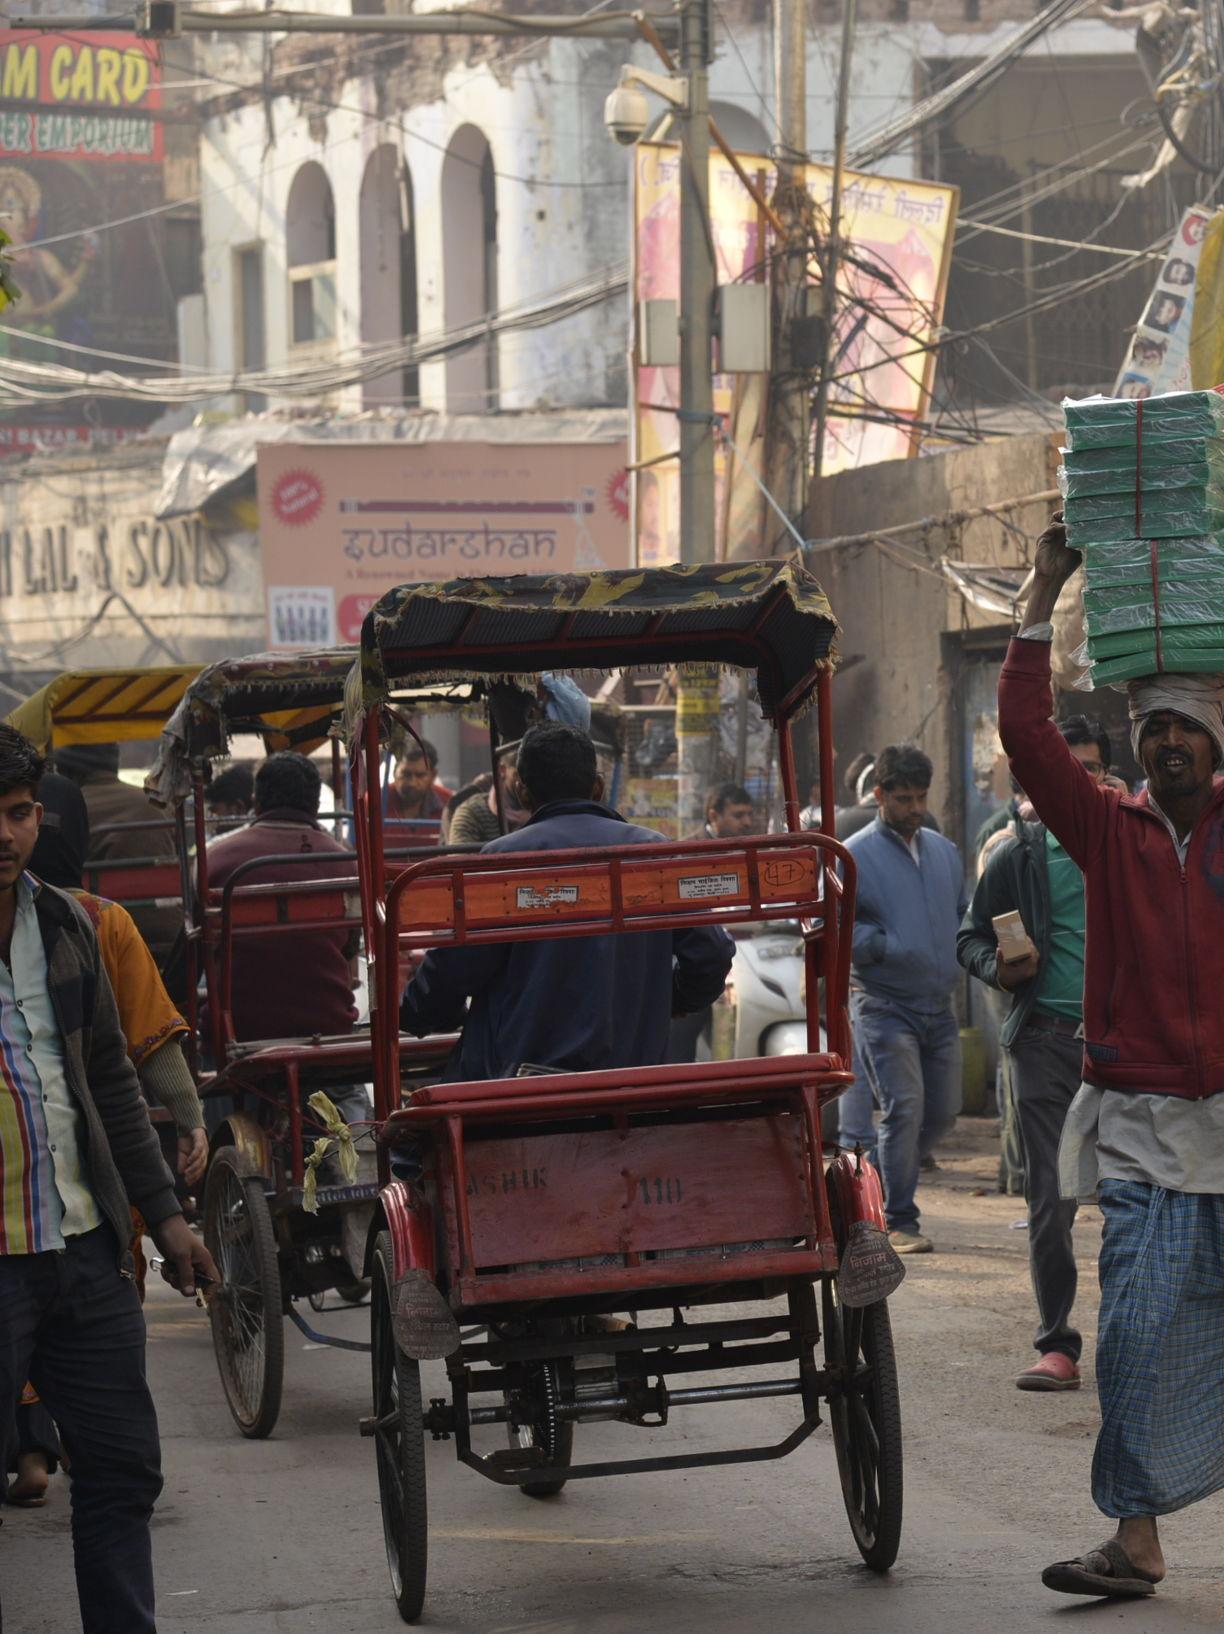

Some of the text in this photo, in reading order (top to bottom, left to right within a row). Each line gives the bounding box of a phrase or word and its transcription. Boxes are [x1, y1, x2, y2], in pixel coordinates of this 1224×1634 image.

[51, 45, 149, 107] CARD
[0, 113, 154, 156] ER EMPORIUM
[24, 524, 78, 595] LAL
[126, 516, 230, 589] SONS
